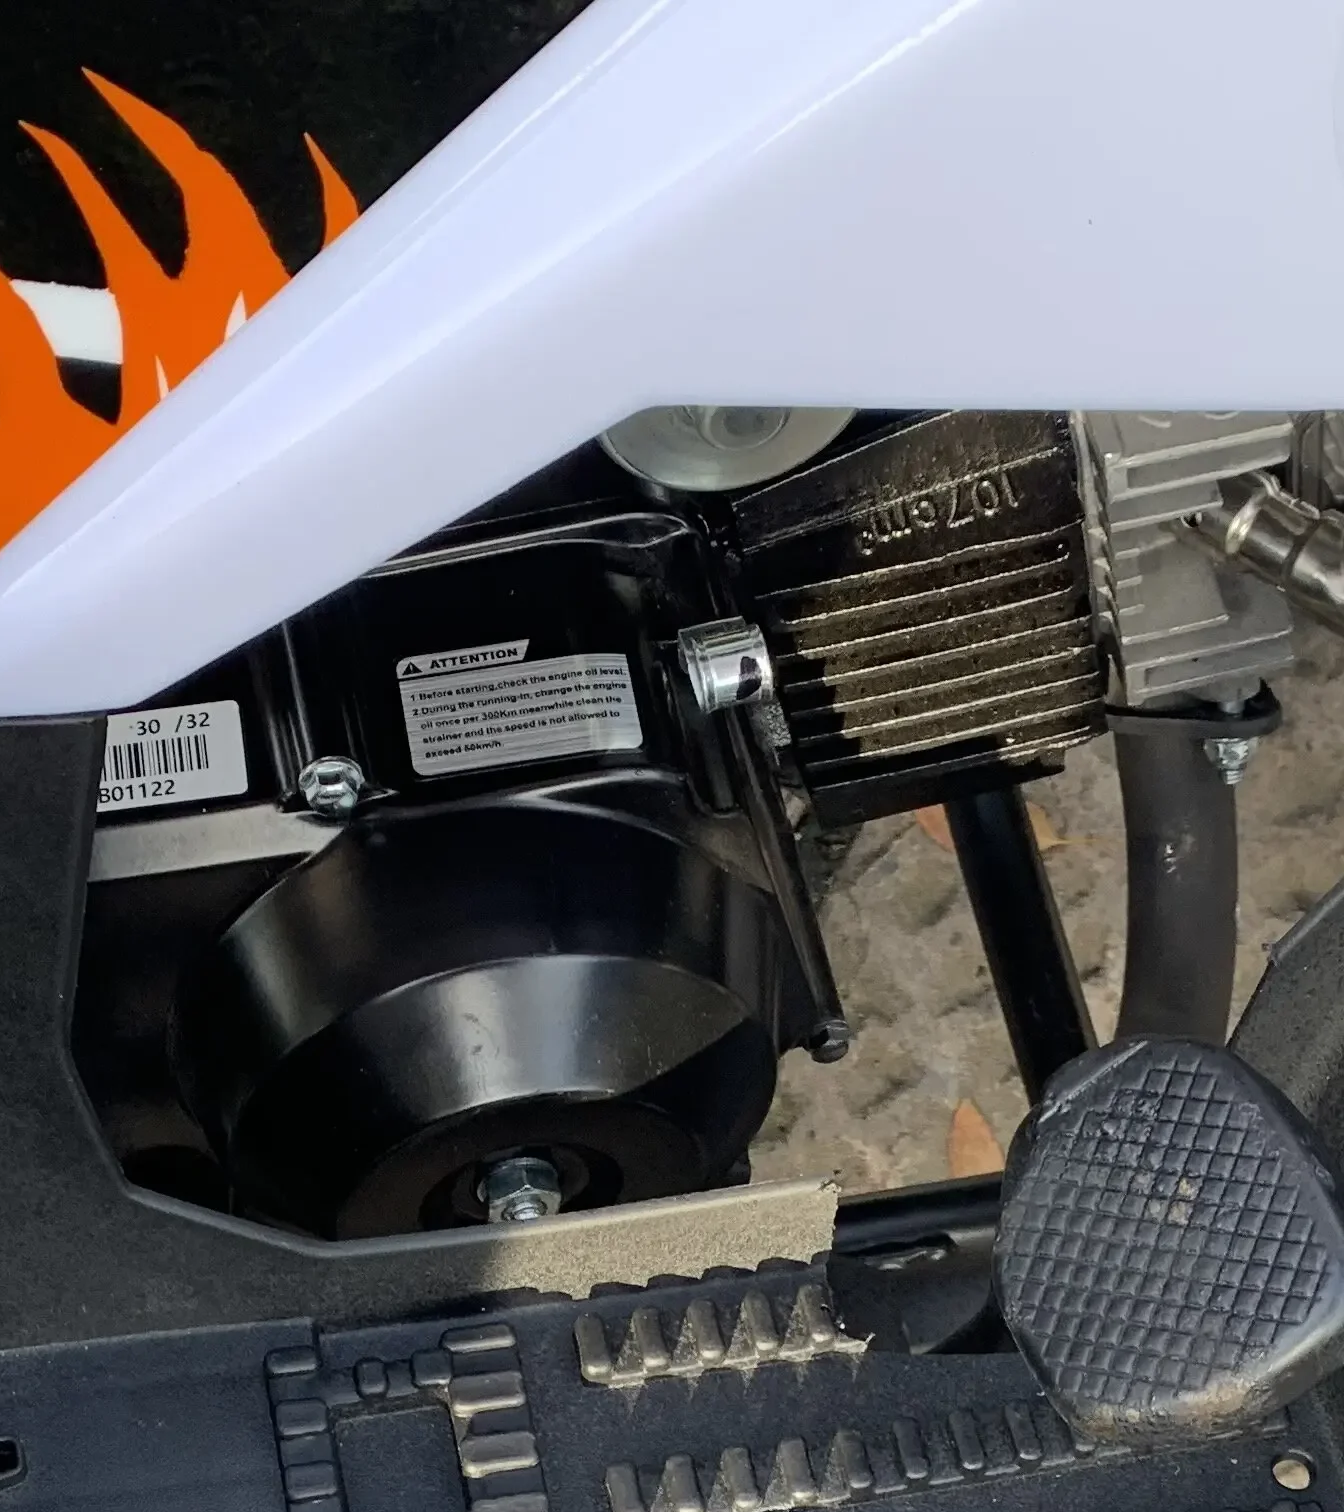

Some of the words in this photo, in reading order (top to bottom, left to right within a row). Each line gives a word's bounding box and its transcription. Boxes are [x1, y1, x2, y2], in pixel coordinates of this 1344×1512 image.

[430, 648, 518, 669] ATTENTION
[530, 674, 545, 684] the
[548, 670, 582, 681] engine
[585, 668, 597, 676] oil
[458, 699, 474, 710] the
[535, 685, 572, 698] change
[574, 683, 590, 692] the
[593, 681, 627, 691] engine
[137, 719, 160, 736] 30
[175, 712, 210, 733] /32
[421, 721, 433, 730] oil
[436, 717, 460, 727] once
[463, 715, 479, 725] per
[519, 701, 574, 715] meanwhile
[576, 696, 603, 706] clean
[605, 695, 622, 704] the
[465, 727, 484, 738] and
[486, 725, 502, 735] the
[504, 719, 535, 732] speed
[538, 718, 547, 726] is
[549, 715, 566, 724] not
[568, 710, 607, 722] allowed
[610, 709, 620, 718] to
[425, 745, 462, 759] exceed
